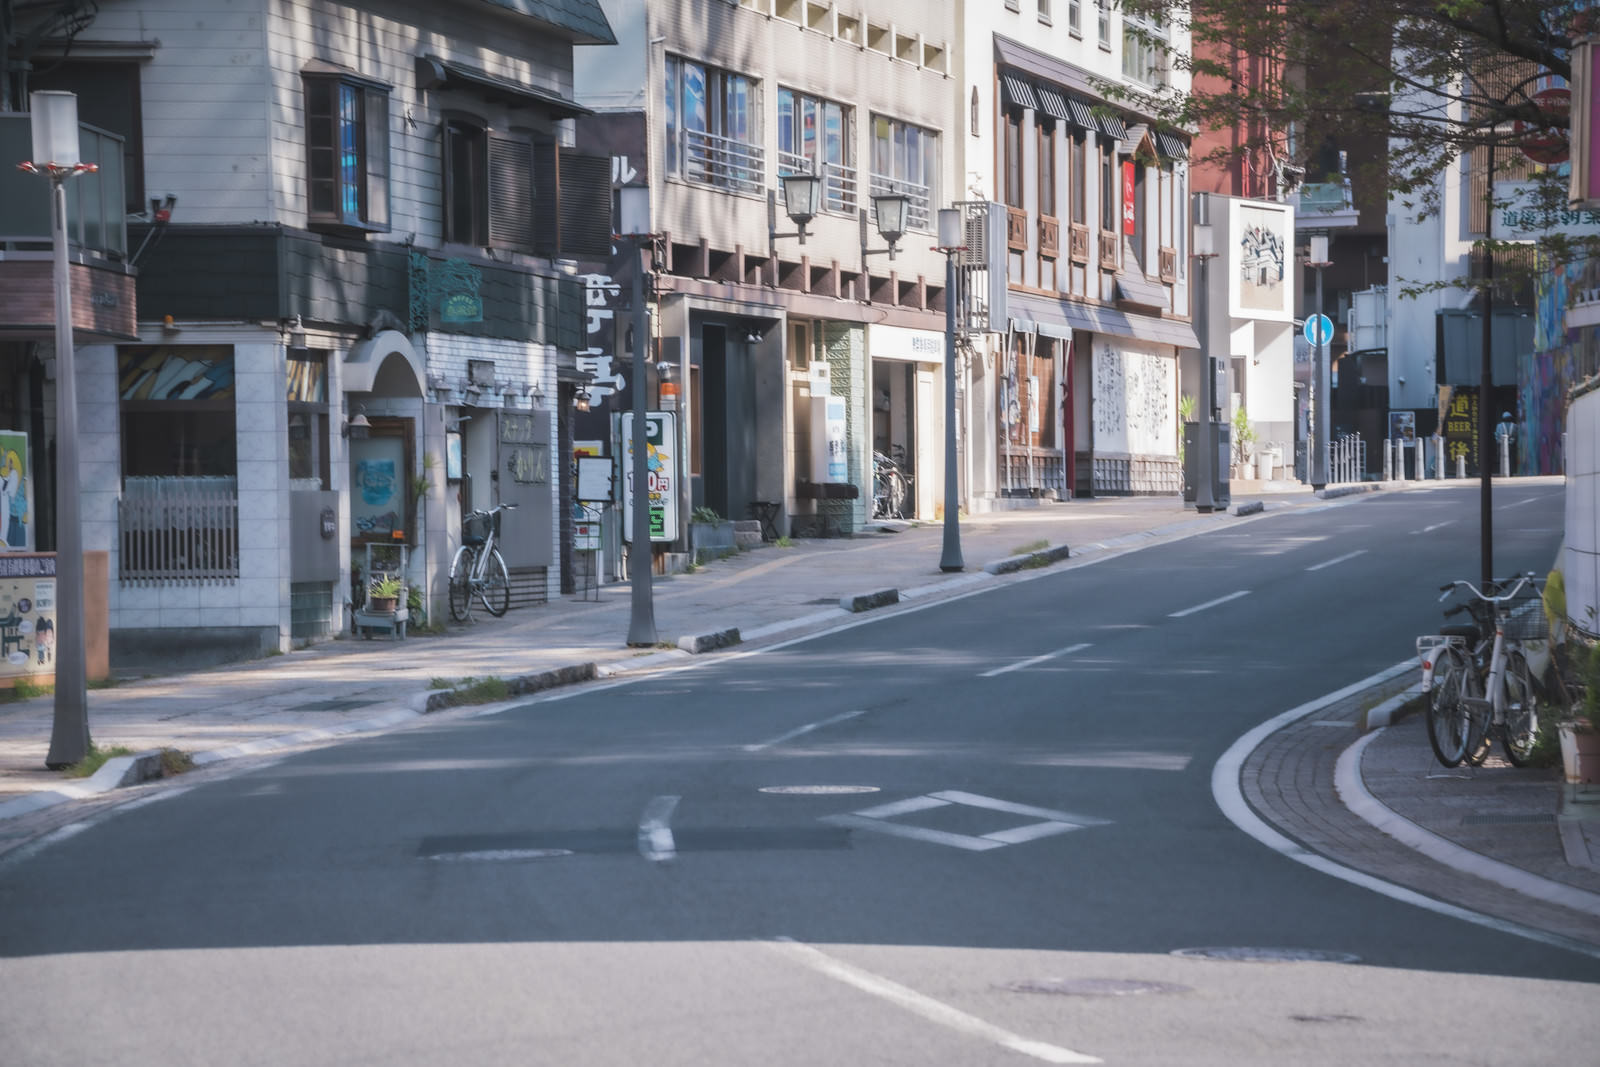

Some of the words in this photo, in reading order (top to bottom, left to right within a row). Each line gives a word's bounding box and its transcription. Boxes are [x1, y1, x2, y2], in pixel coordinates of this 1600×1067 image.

[503, 418, 532, 441] スナック
[1447, 421, 1471, 433] BEER
[516, 447, 545, 481] かりん
[627, 471, 670, 492] 10円
